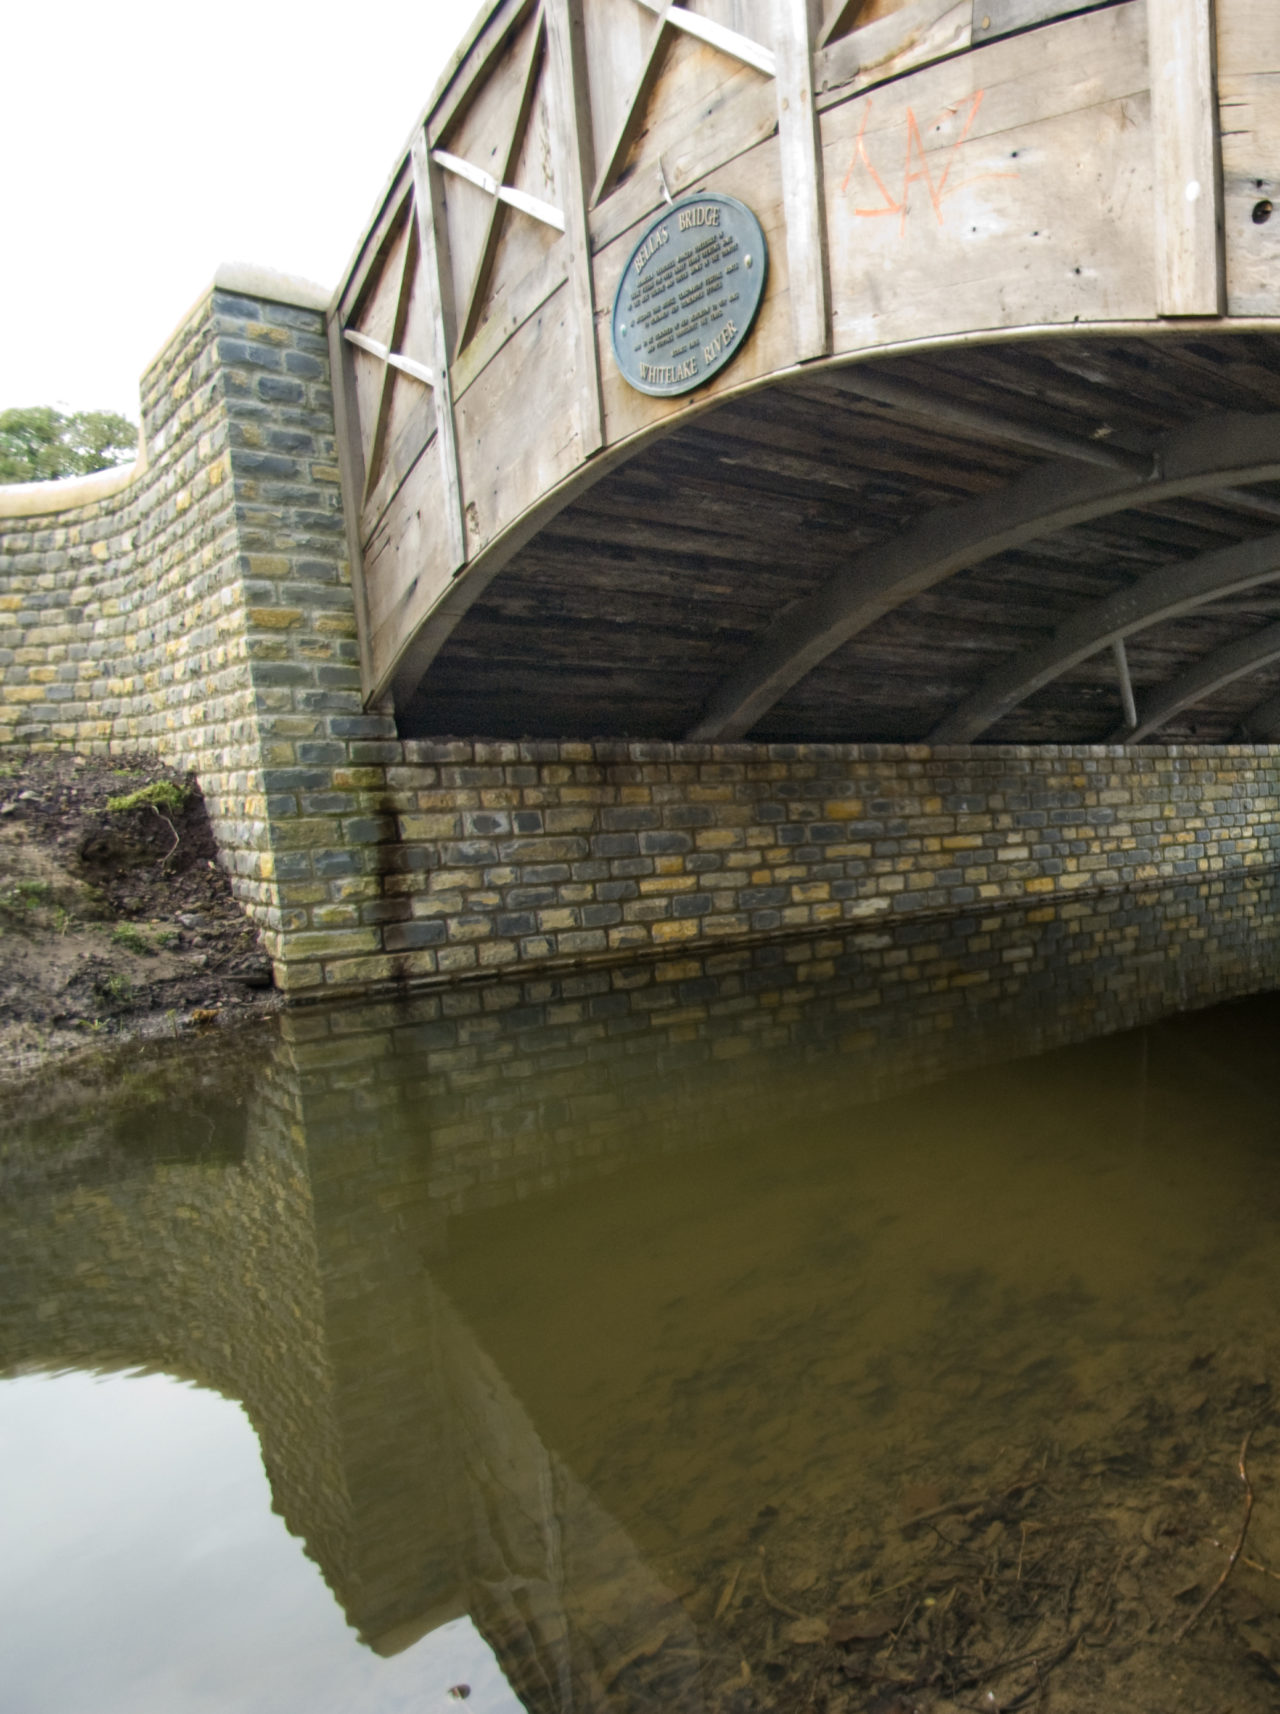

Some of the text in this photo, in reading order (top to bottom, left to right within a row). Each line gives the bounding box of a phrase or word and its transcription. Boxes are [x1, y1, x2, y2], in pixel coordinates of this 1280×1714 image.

[634, 226, 669, 274] BELLA'S
[678, 206, 719, 231] BRIDGE
[639, 357, 698, 384] WHITELAKE
[704, 321, 738, 366] RIVER
